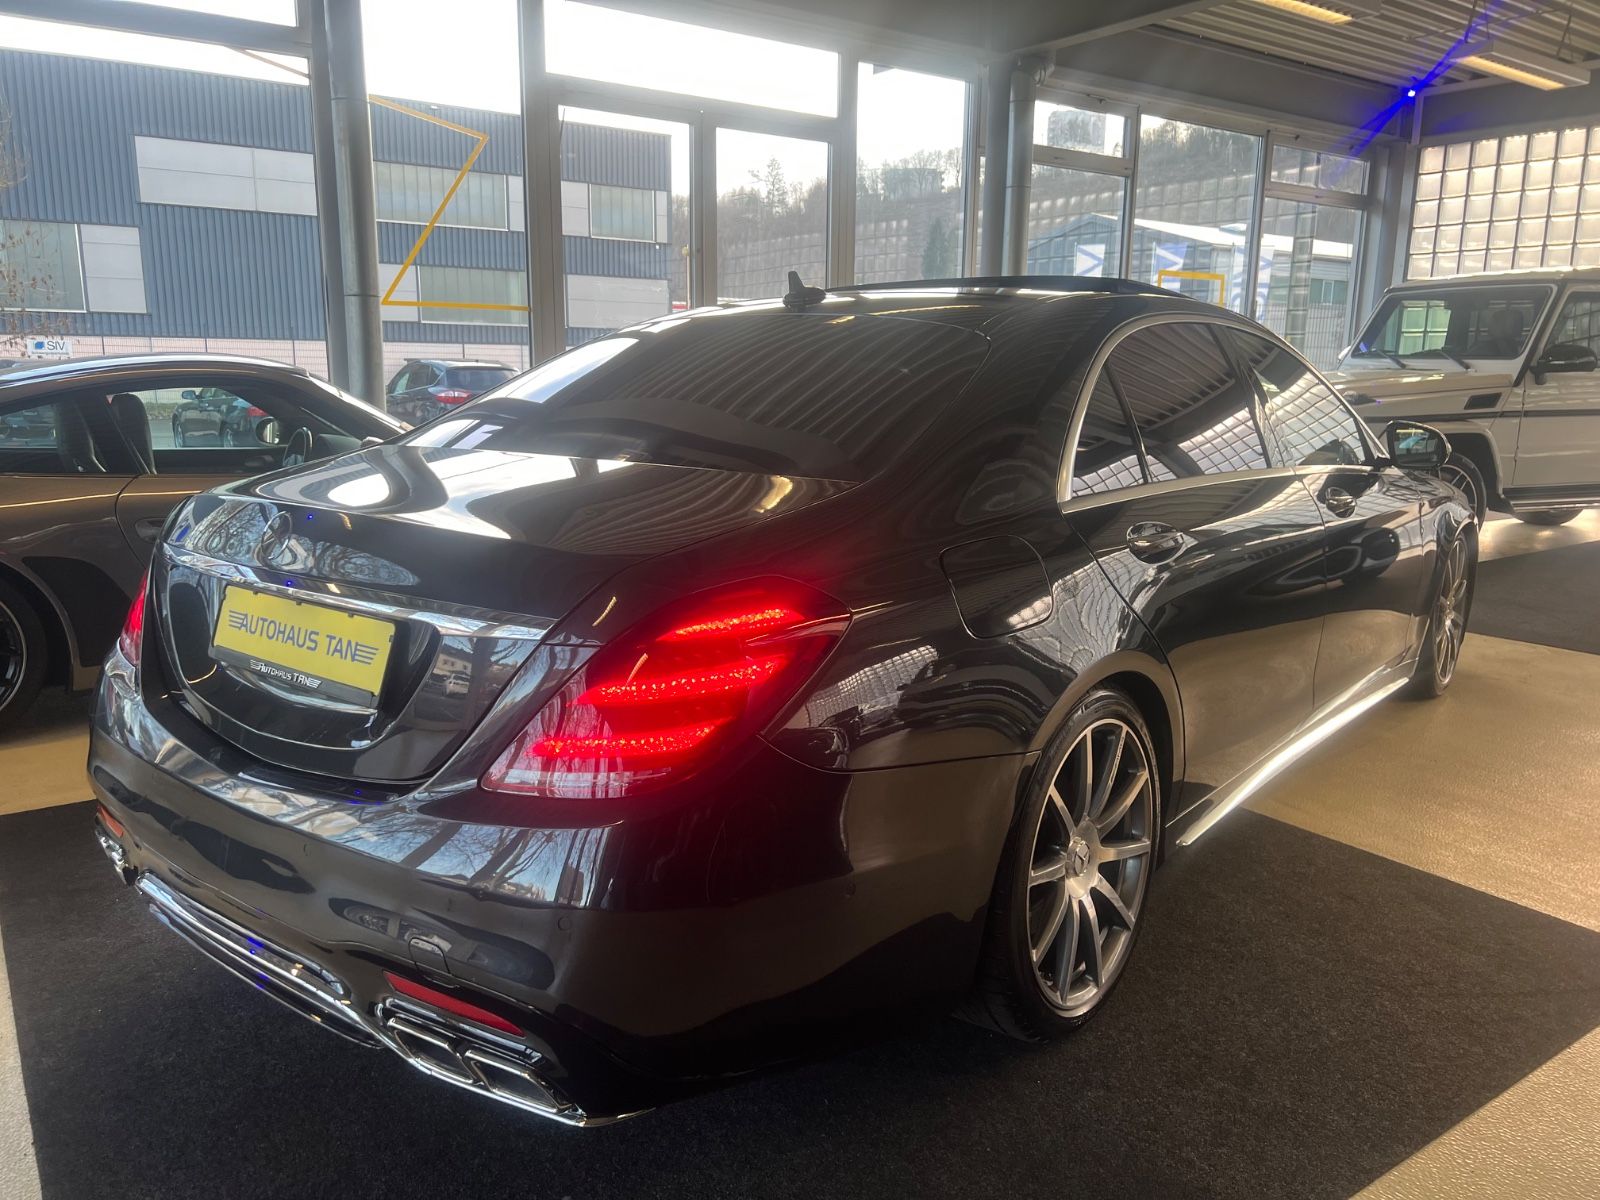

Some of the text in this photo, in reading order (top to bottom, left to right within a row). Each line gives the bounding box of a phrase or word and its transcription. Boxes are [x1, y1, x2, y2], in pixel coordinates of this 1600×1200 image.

[47, 340, 66, 350] SIV
[239, 612, 358, 662] AUTOHAUS TAN
[259, 662, 310, 686] AUTOHAUS TAN
